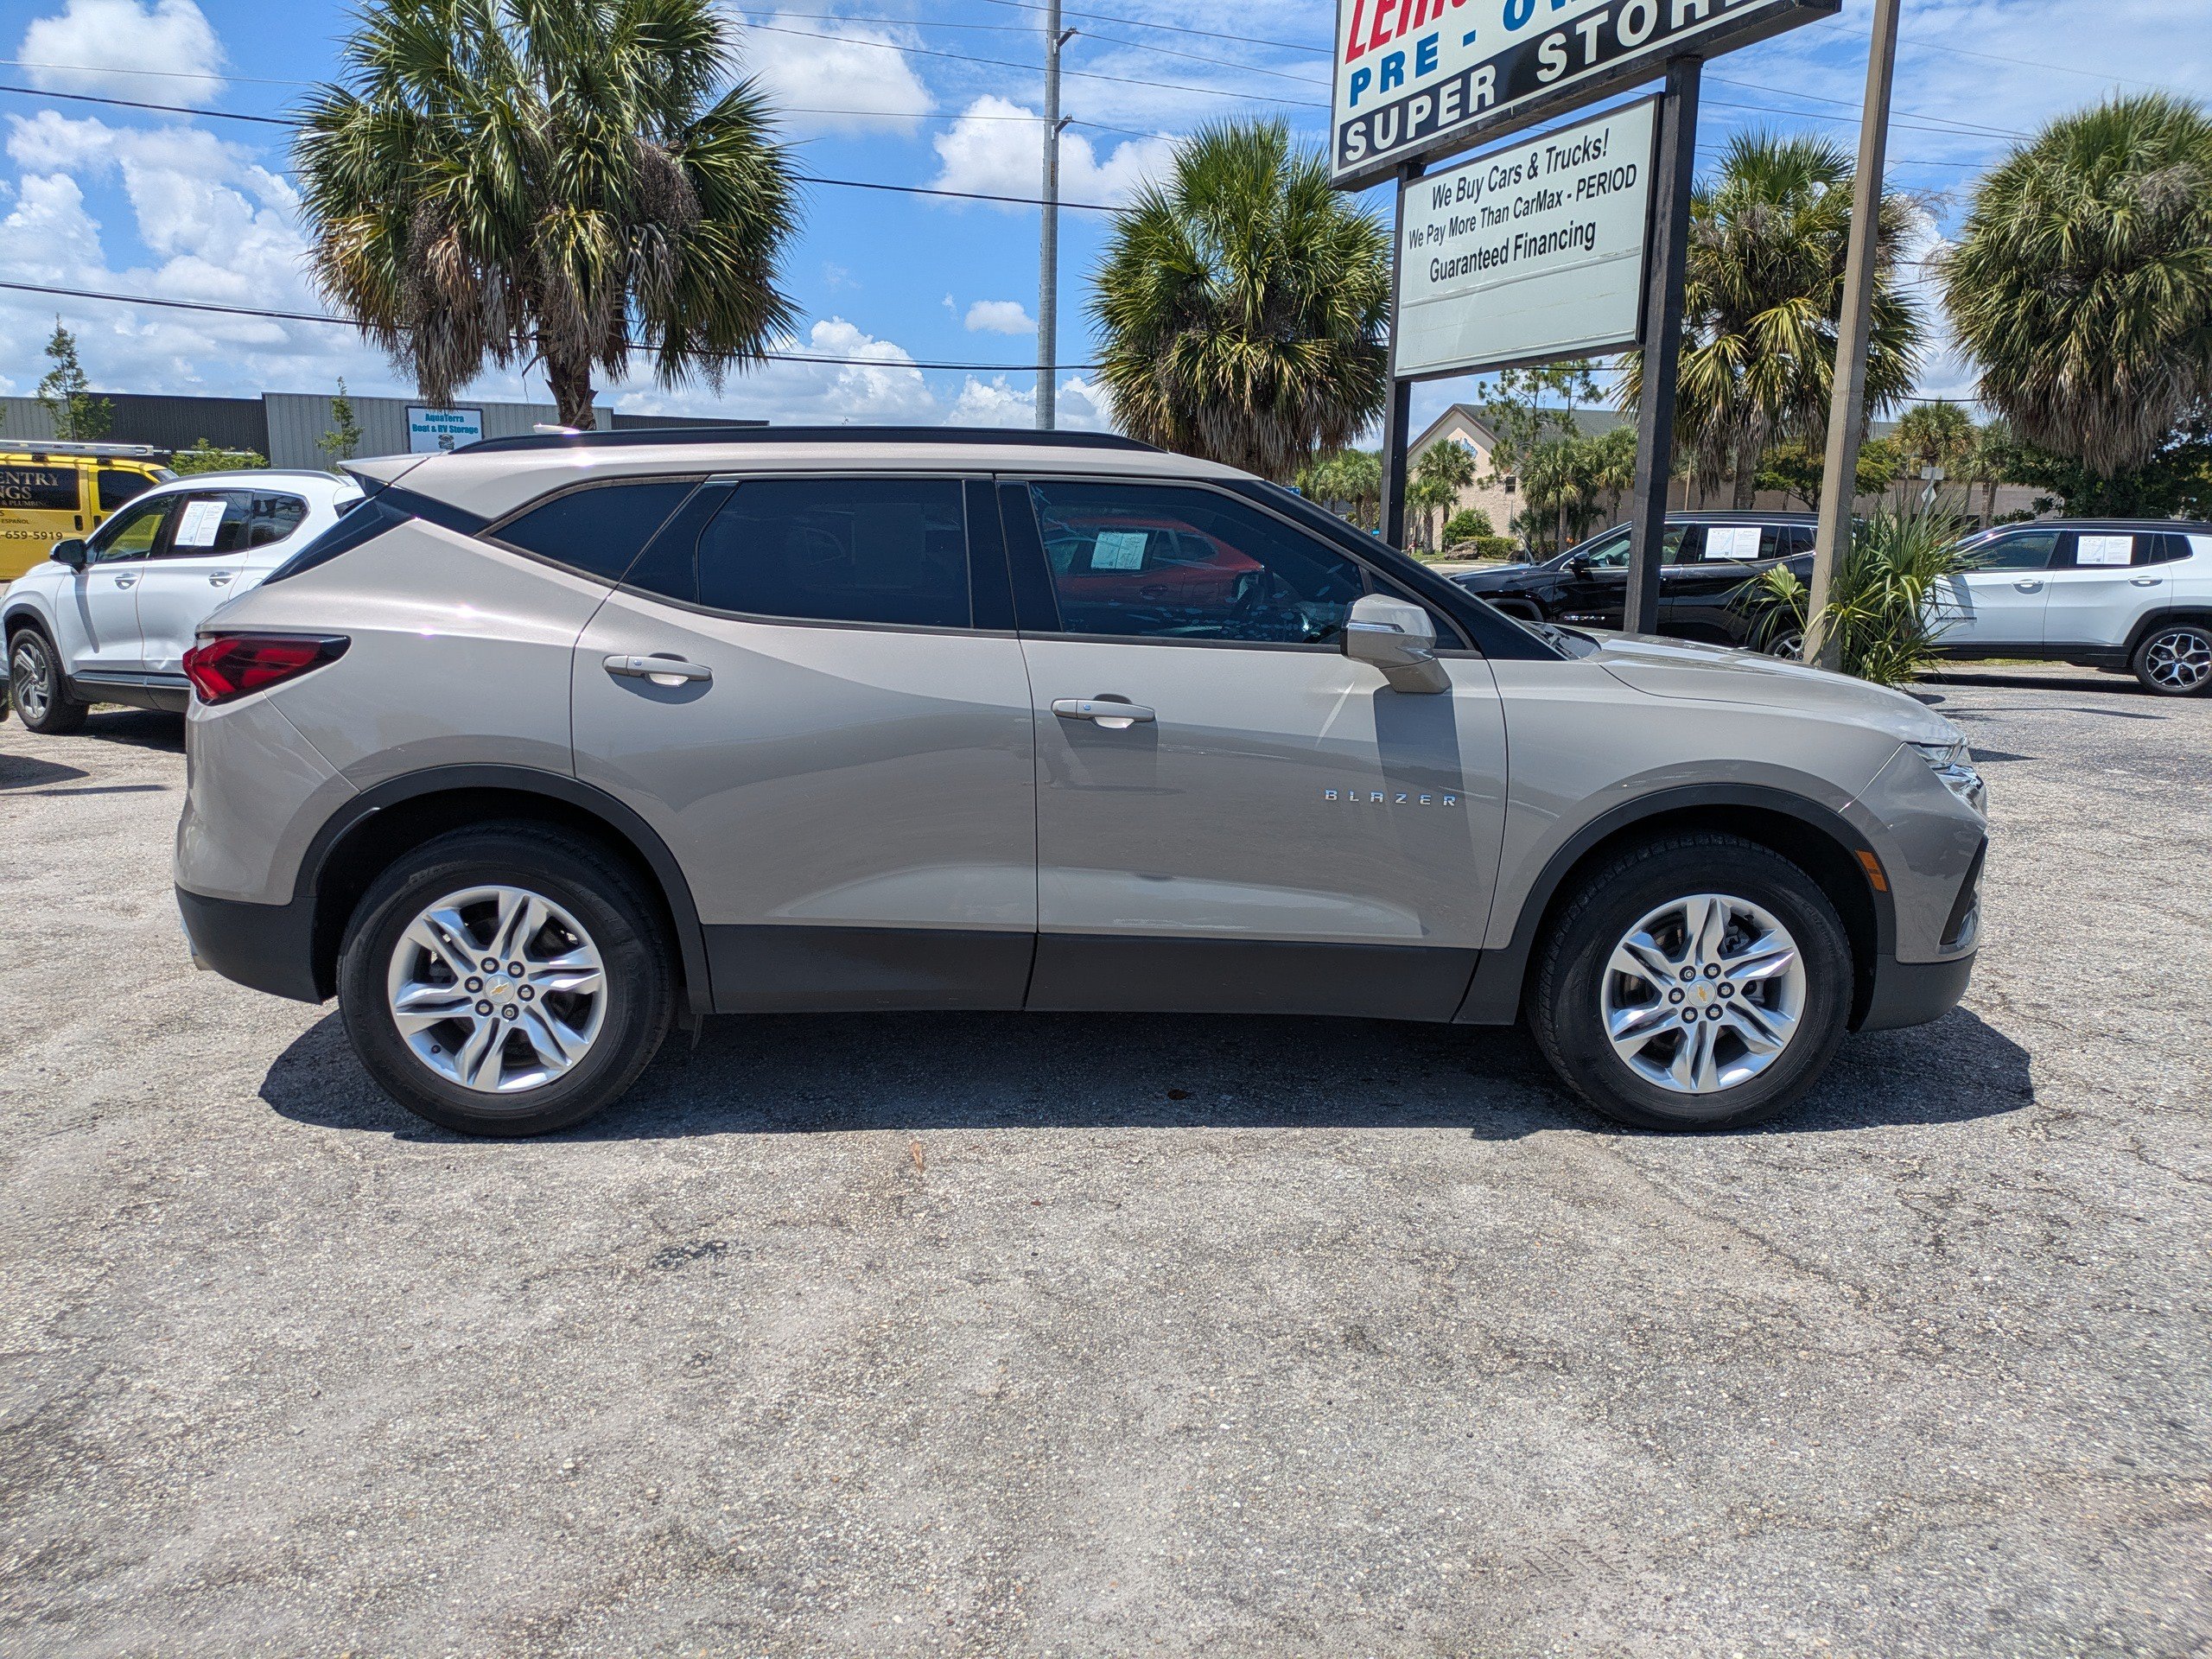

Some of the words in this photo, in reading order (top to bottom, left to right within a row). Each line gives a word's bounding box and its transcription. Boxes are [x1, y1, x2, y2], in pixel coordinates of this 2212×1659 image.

[1345, 65, 1496, 162] SUPER
[1536, 0, 1745, 83] STOR
[1350, 32, 1439, 108] PRE
[1432, 185, 1452, 210] We
[1456, 176, 1484, 204] Buy
[1488, 163, 1522, 192] Cars
[1527, 152, 1539, 180] &
[1546, 128, 1609, 175] Trucks!
[1409, 227, 1424, 250] We
[1427, 223, 1446, 246] Pay
[1449, 215, 1476, 238] More
[1480, 205, 1510, 229] Than
[1513, 189, 1563, 219] CarMax
[1576, 163, 1637, 202] PERIOD
[1430, 238, 1510, 283] Guaranteed
[1514, 220, 1596, 261] Financing
[425, 413, 464, 423] AquaTerra
[449, 425, 479, 435] Storage
[1325, 790, 1456, 806] BLAZER
